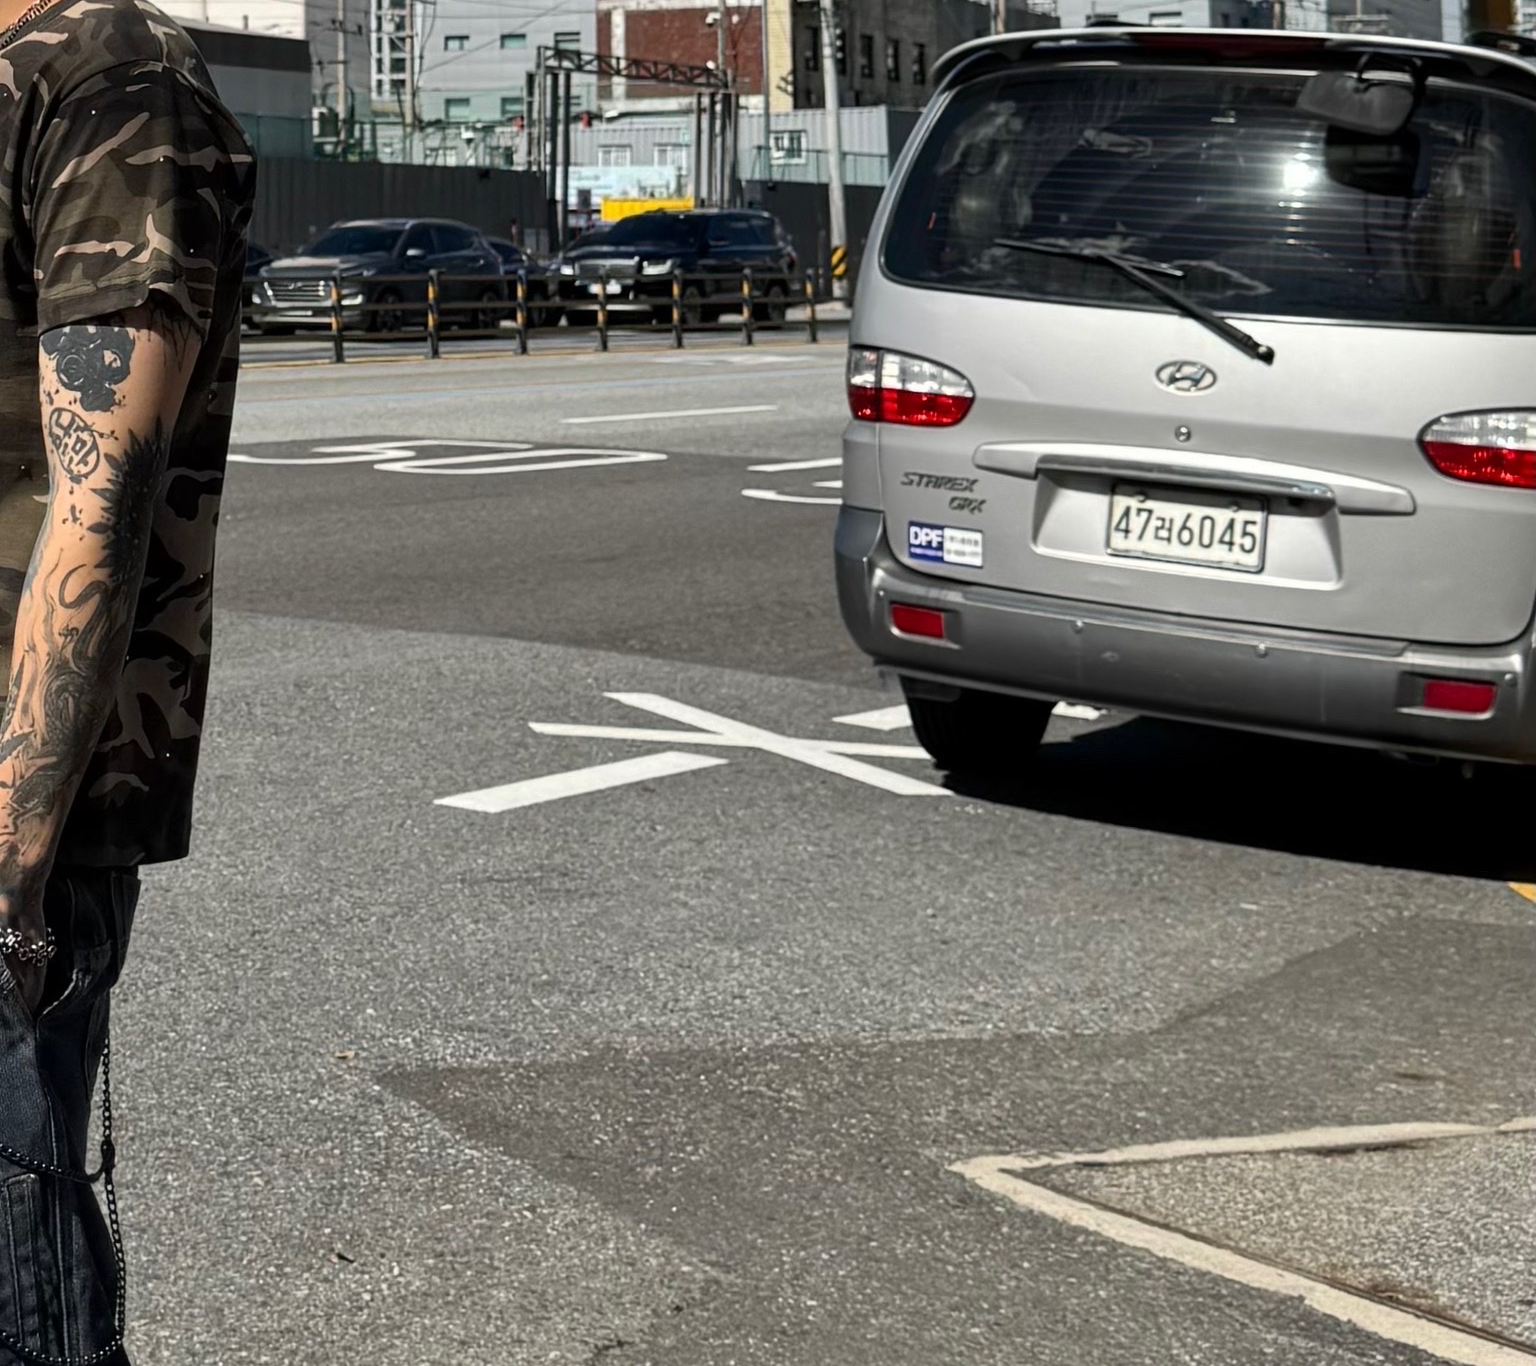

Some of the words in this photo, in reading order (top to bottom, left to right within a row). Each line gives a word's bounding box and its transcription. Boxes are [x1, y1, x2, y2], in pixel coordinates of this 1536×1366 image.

[900, 472, 979, 493] STAREX
[948, 496, 986, 515] GRX
[909, 525, 944, 549] DPF
[1114, 505, 1258, 554] 47러6045
